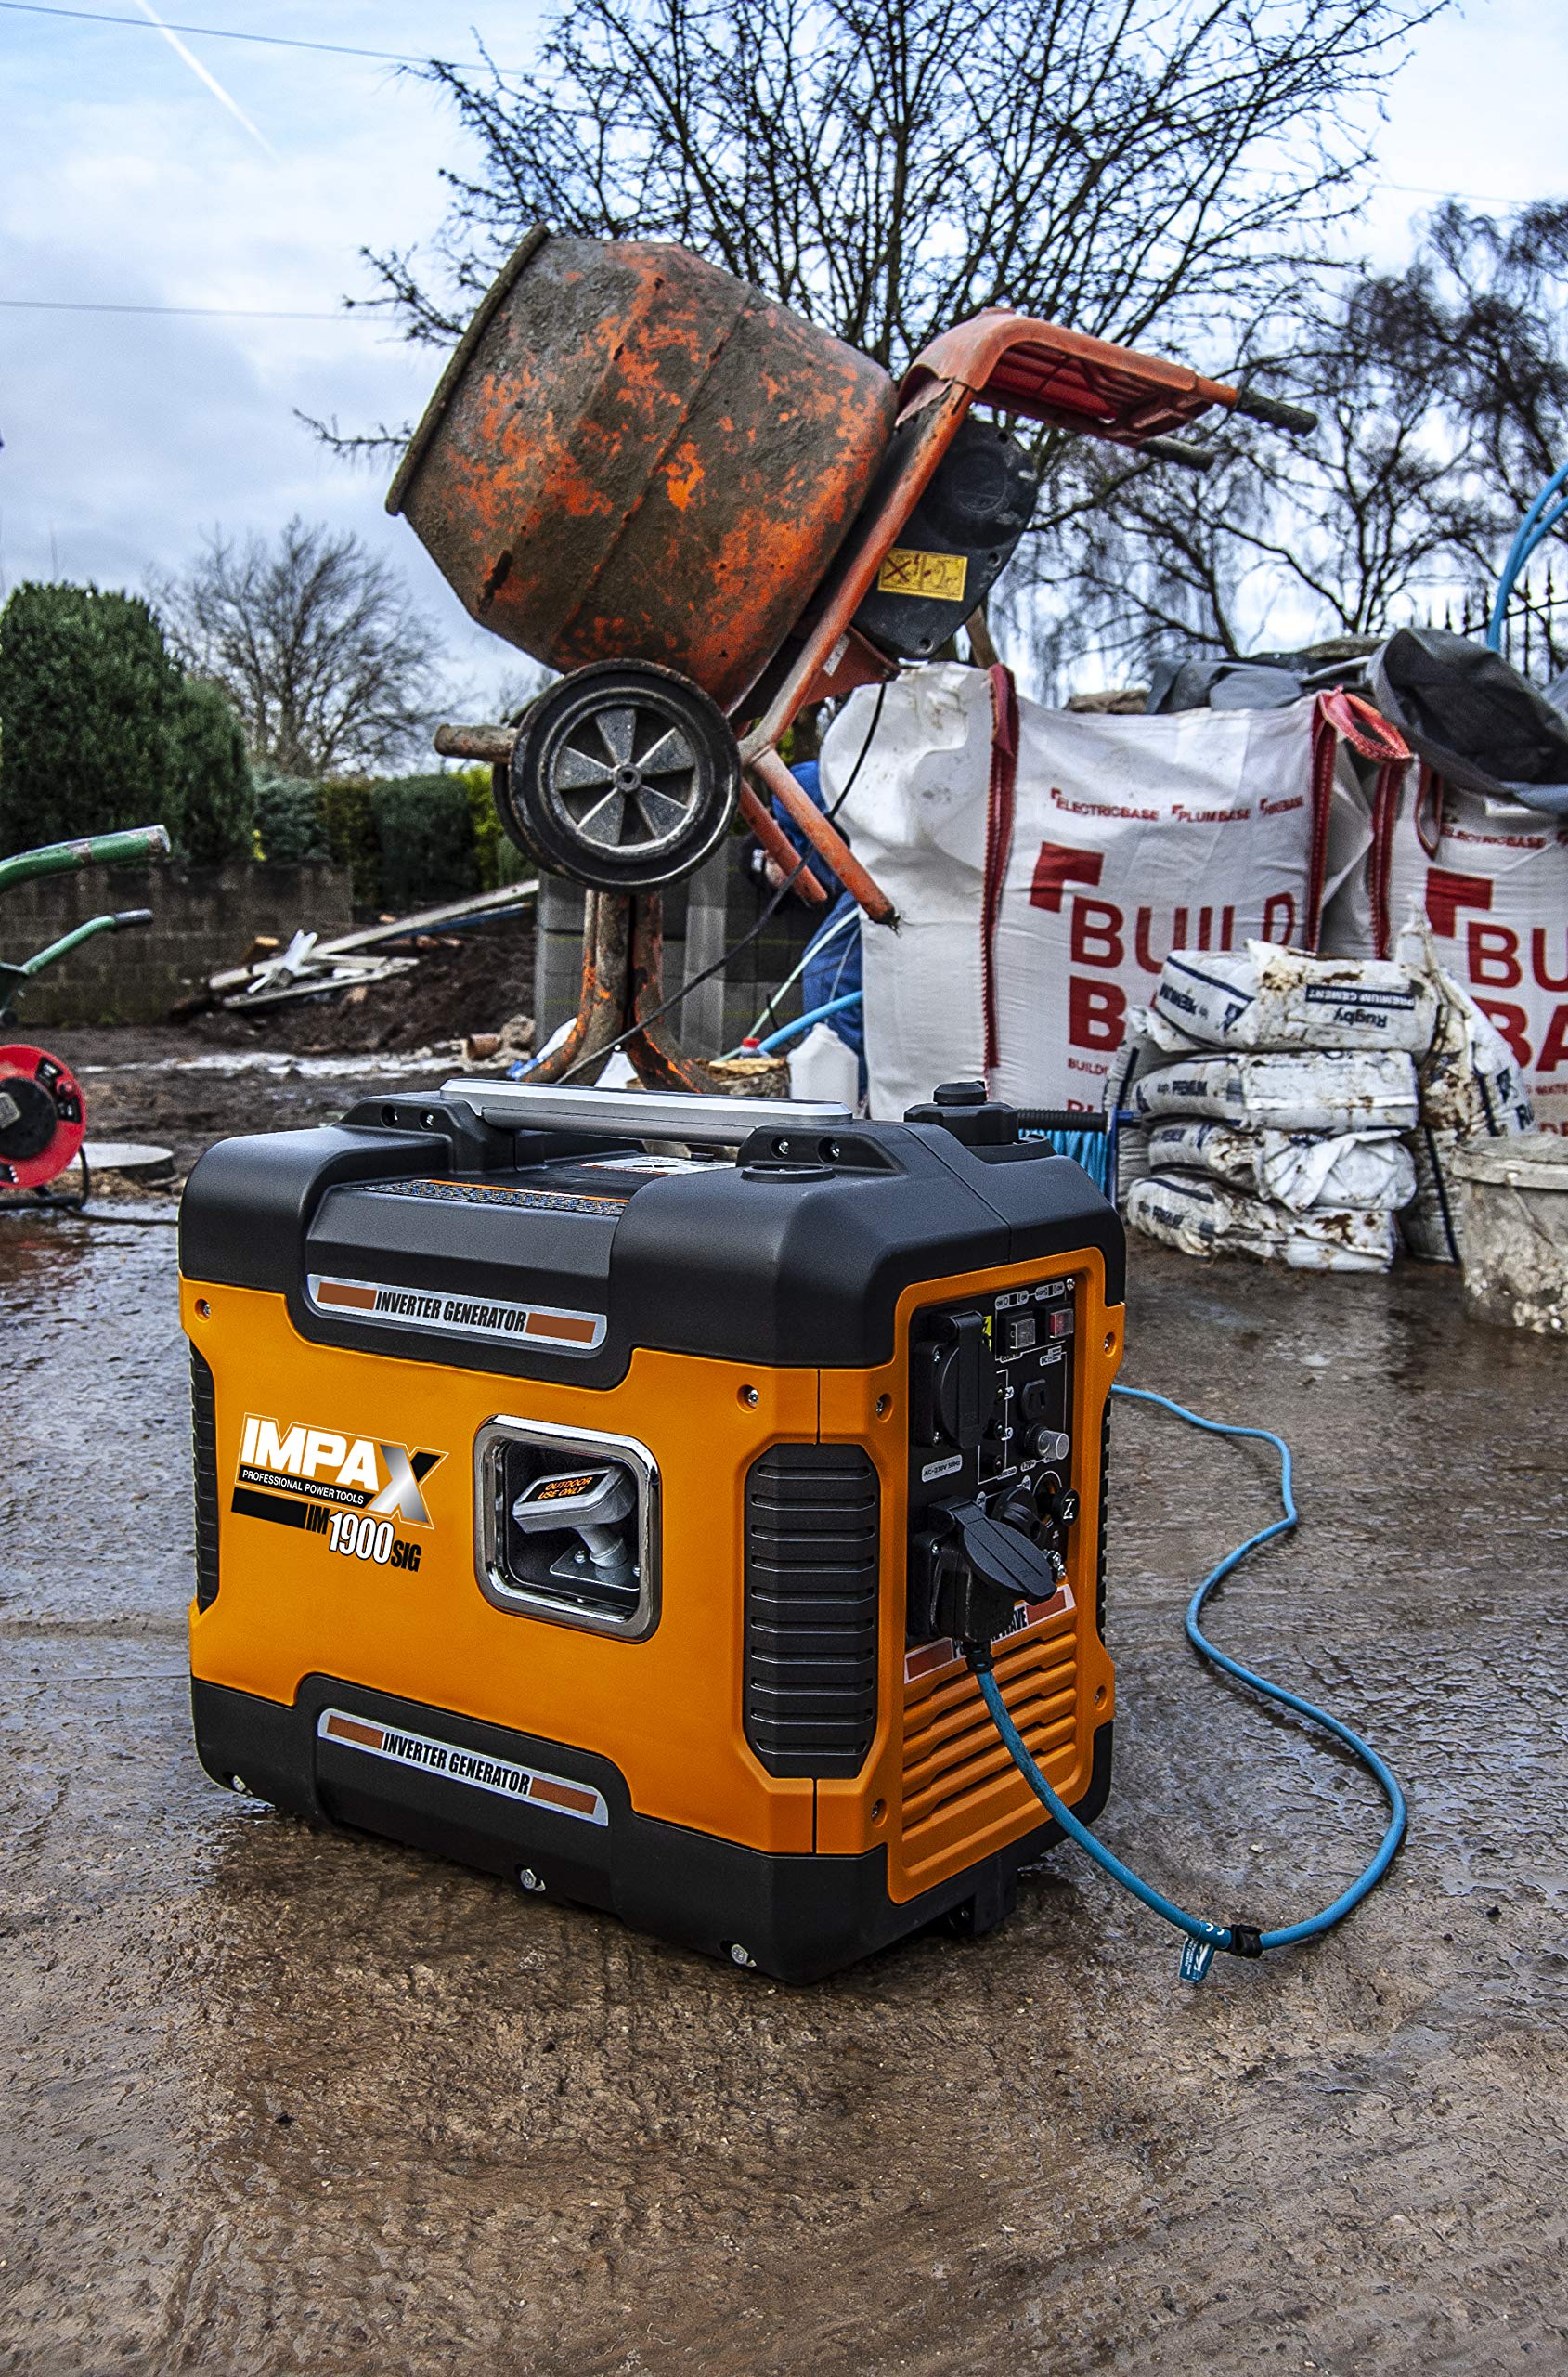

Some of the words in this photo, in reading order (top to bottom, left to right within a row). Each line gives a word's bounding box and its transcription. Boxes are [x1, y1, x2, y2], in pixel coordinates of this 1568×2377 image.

[1333, 1007, 1388, 1028] Rugby
[375, 1291, 442, 1319] INVERTER
[443, 1300, 527, 1332] GENERATOR
[240, 1417, 442, 1524] IMPAX
[242, 1469, 303, 1492] PROFESSIONAL
[305, 1483, 335, 1499] POWER
[336, 1489, 364, 1505] TOOLS
[545, 1476, 593, 1491] OUTDOOR
[538, 1489, 558, 1500] USE
[558, 1486, 586, 1497] ONLY
[383, 1732, 447, 1770] INVERTER
[448, 1753, 530, 1795] GENERATOR
